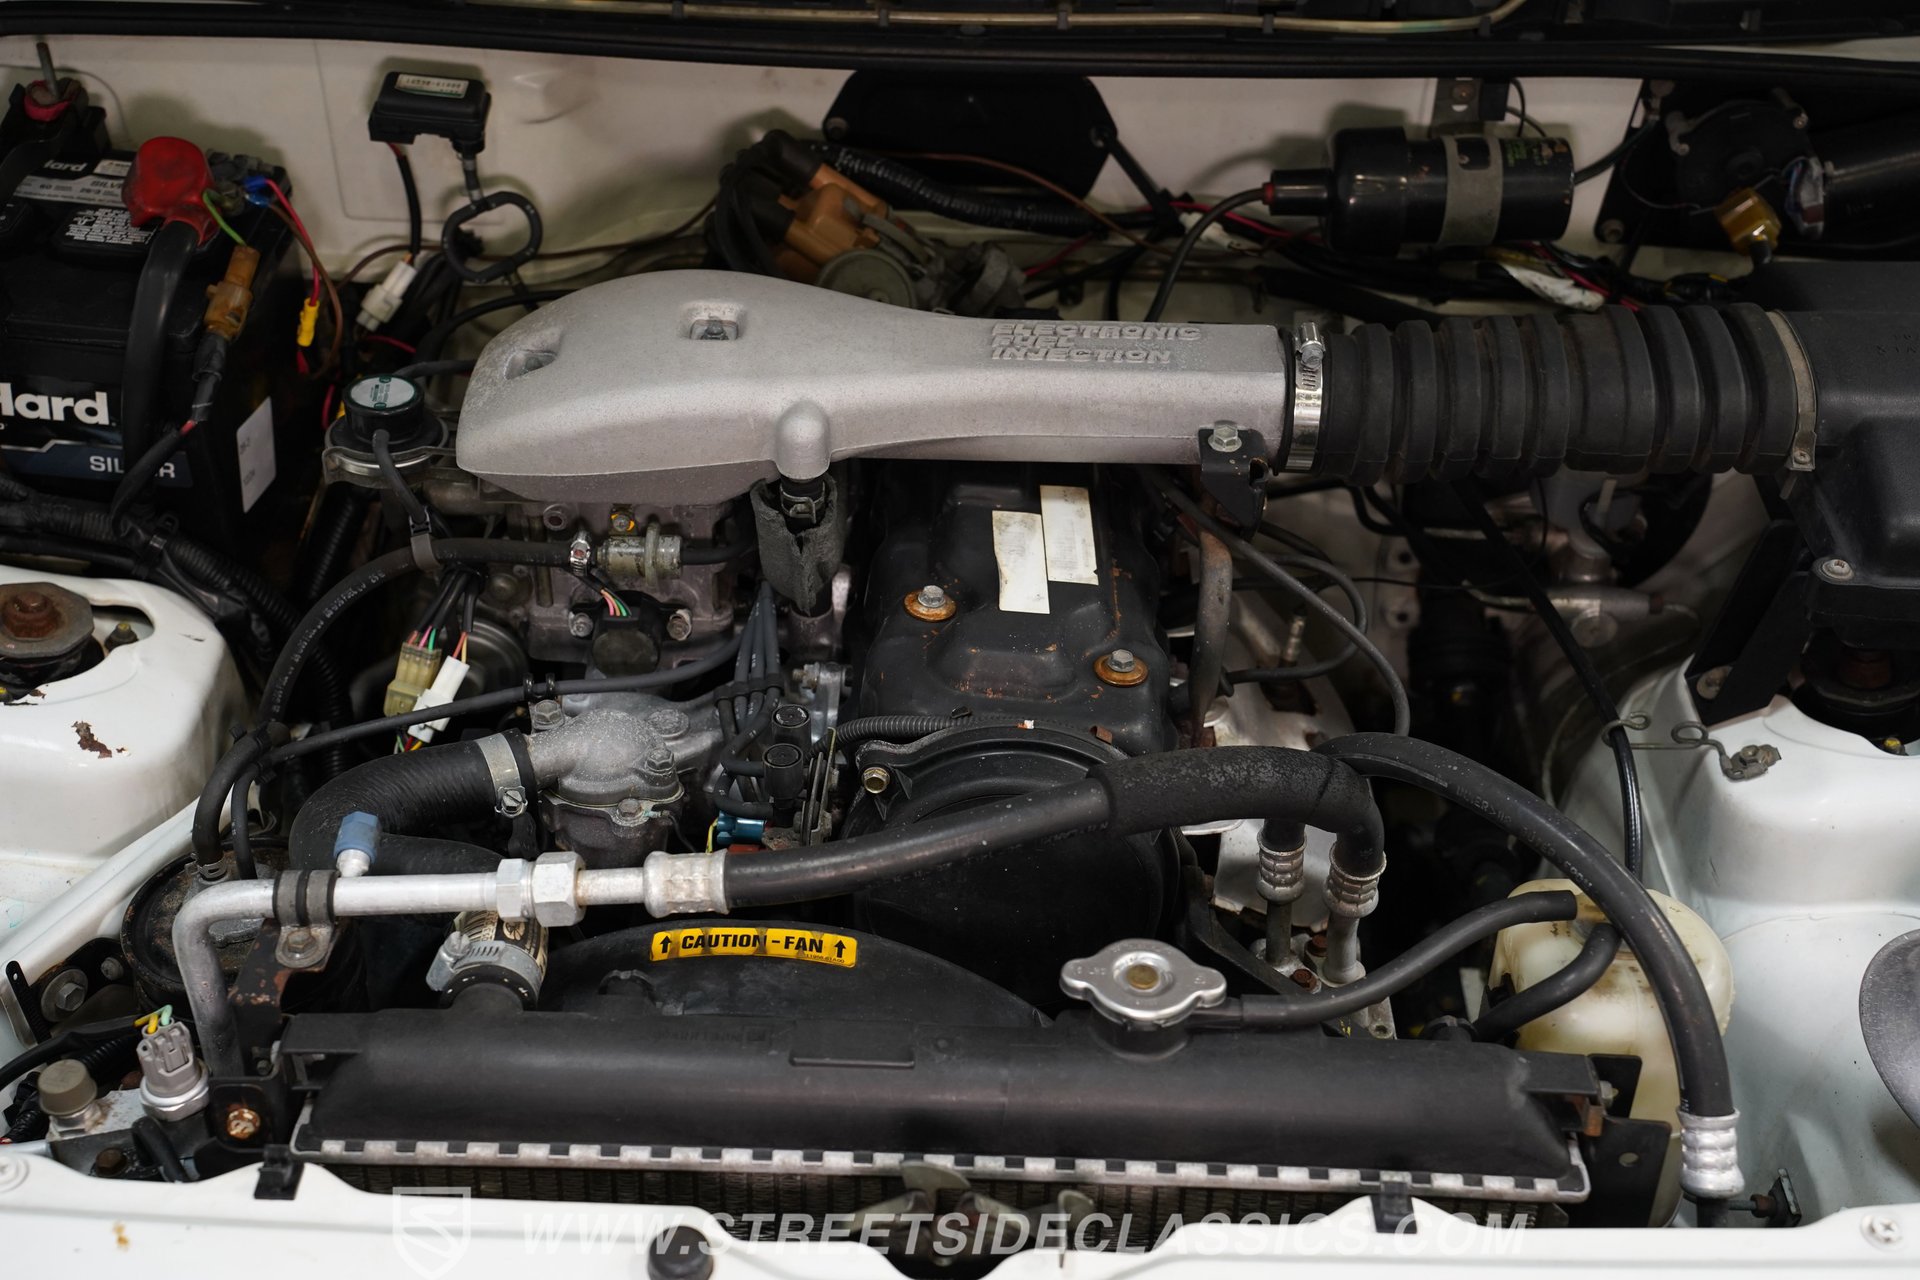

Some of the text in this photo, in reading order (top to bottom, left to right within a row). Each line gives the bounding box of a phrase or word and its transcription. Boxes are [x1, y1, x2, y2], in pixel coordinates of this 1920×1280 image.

[992, 323, 1201, 341] ELECTRONIC
[992, 335, 1075, 349] FUEL
[992, 348, 1171, 364] INJECTION
[89, 455, 175, 478] SILR
[681, 934, 766, 949] CAUTION
[784, 935, 823, 953] FAN
